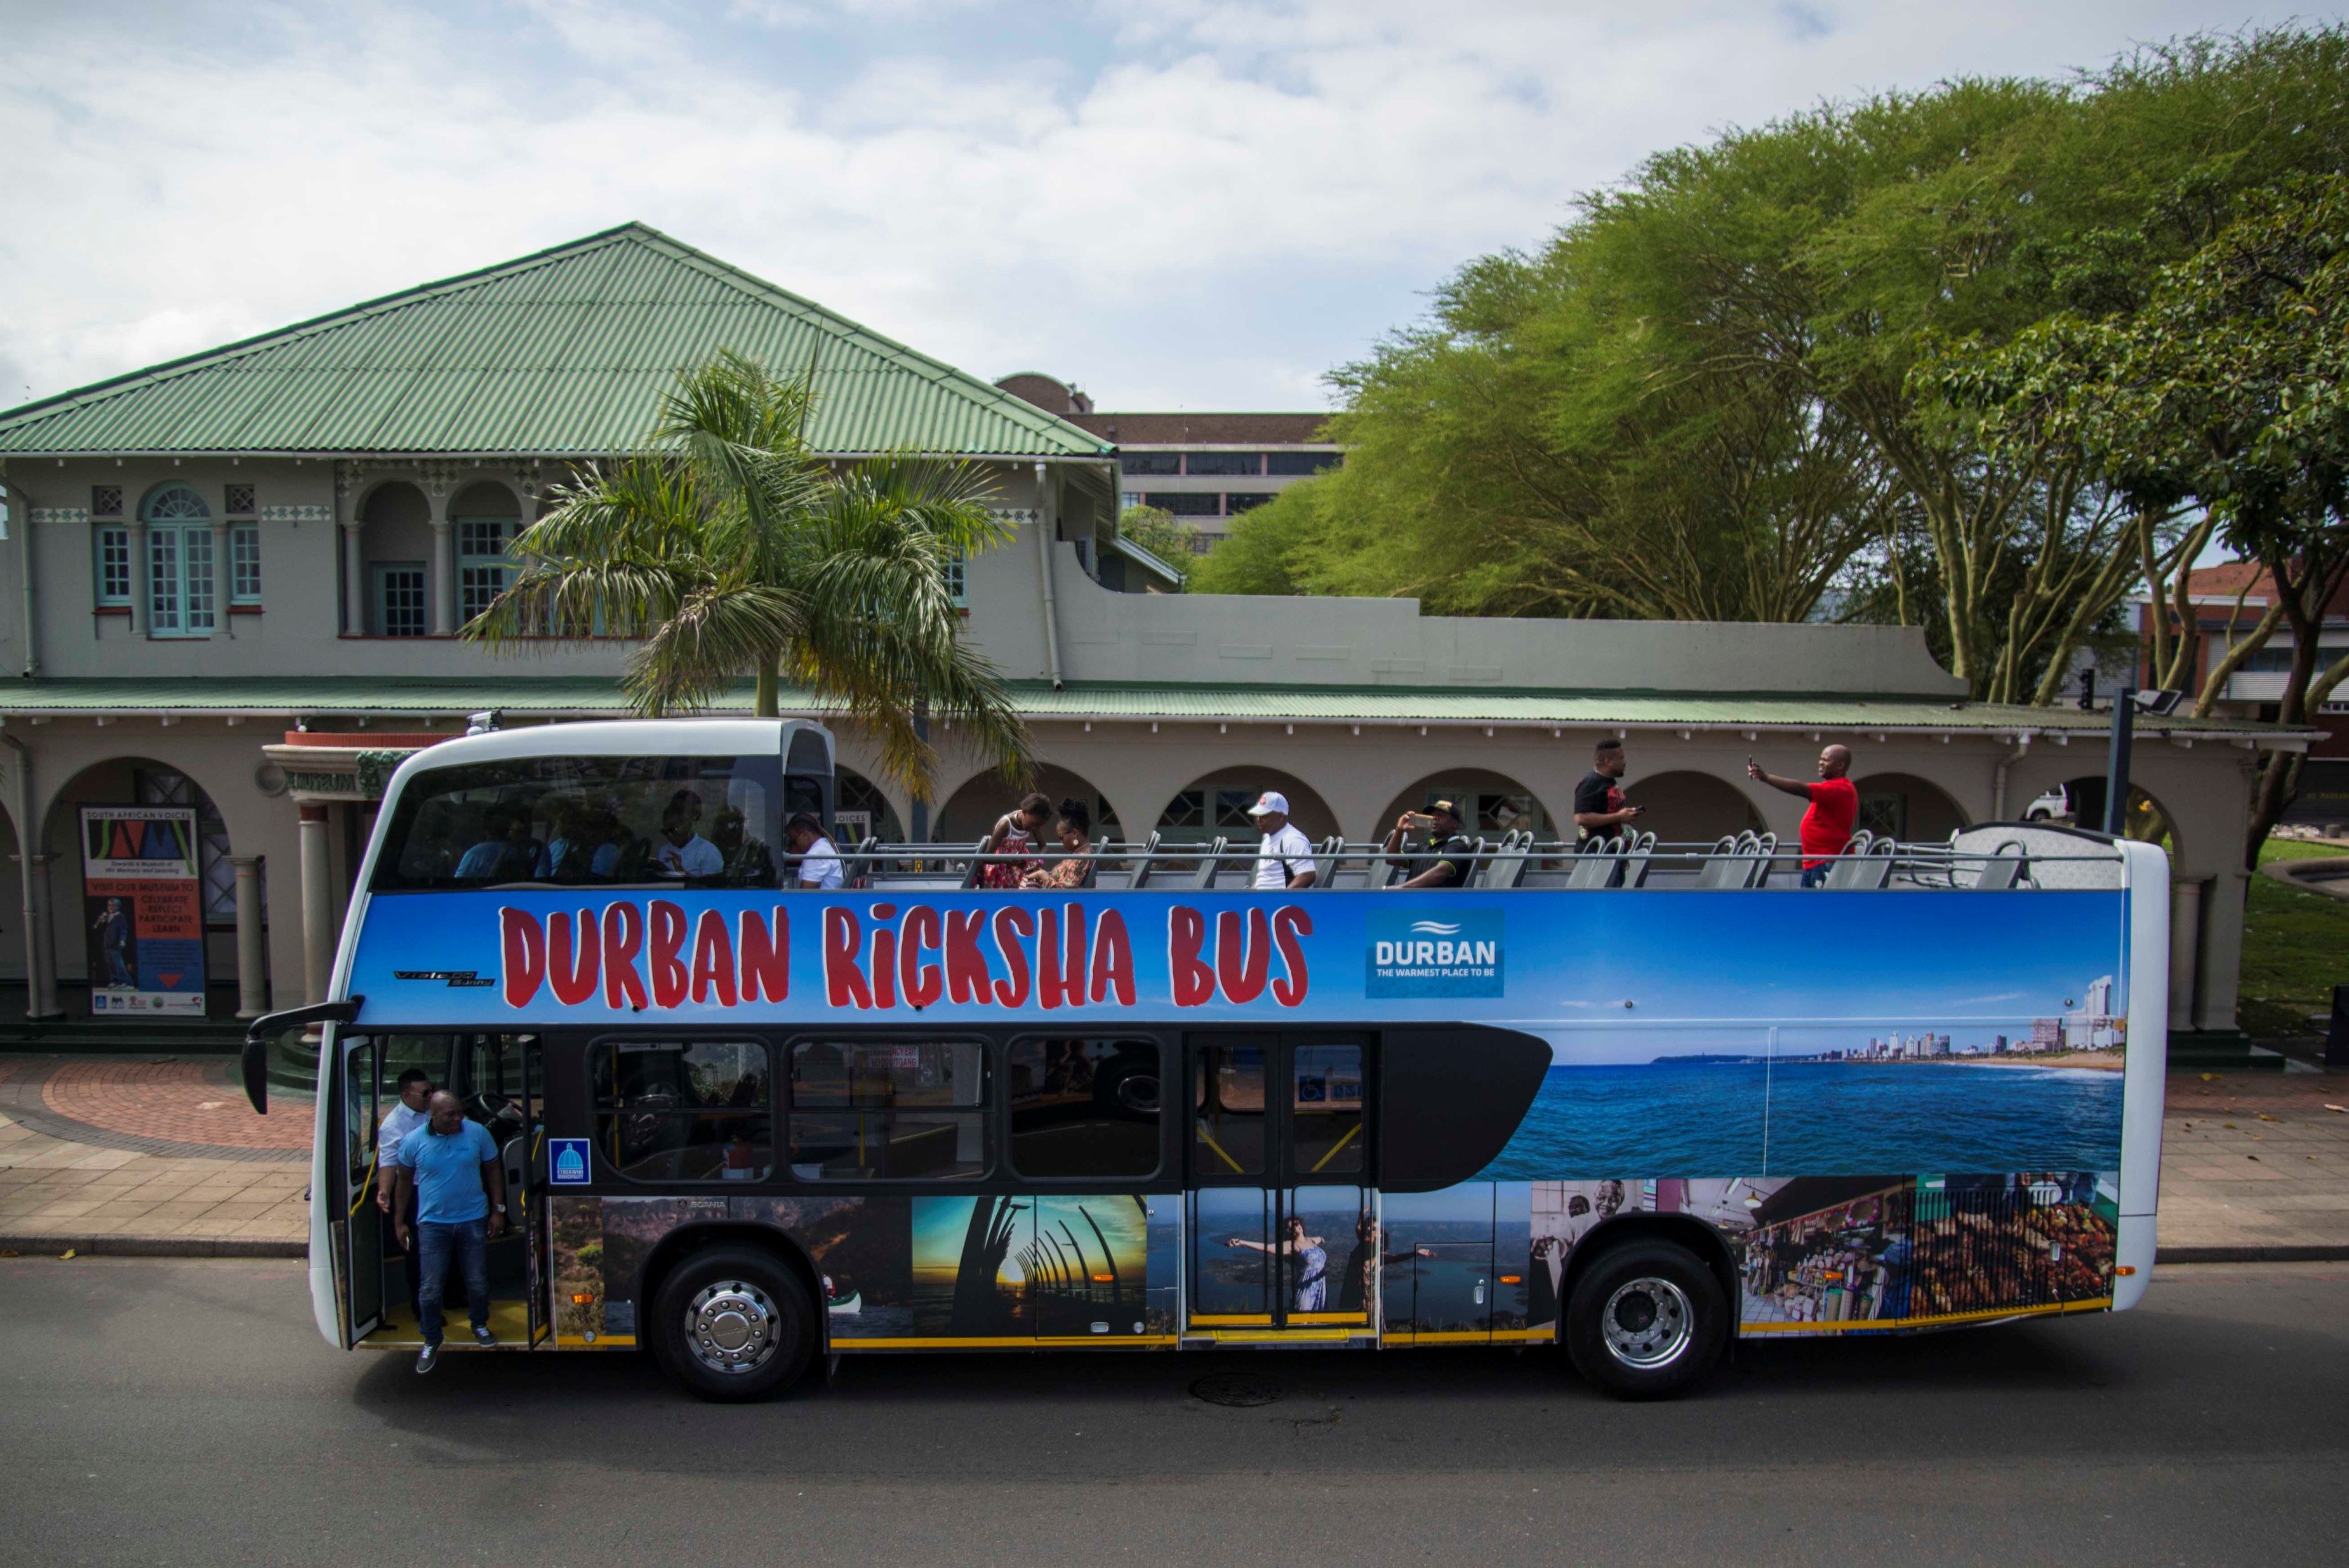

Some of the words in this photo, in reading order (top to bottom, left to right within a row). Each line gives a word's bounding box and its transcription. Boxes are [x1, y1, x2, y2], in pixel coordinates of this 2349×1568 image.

[296, 772, 356, 791] MUSEUM
[139, 883, 179, 891] MUSEUM
[182, 883, 194, 891] TO
[138, 915, 193, 923] PARTICIPATE
[498, 900, 790, 1009] DURBAN
[1168, 904, 1314, 1008] BUS
[1376, 941, 1495, 966] DURBAN
[1376, 968, 1394, 977] THE
[1395, 968, 1439, 977] WARMEST
[1442, 968, 1469, 977] PLACE
[1471, 968, 1482, 977] TO
[1484, 968, 1495, 977] BE
